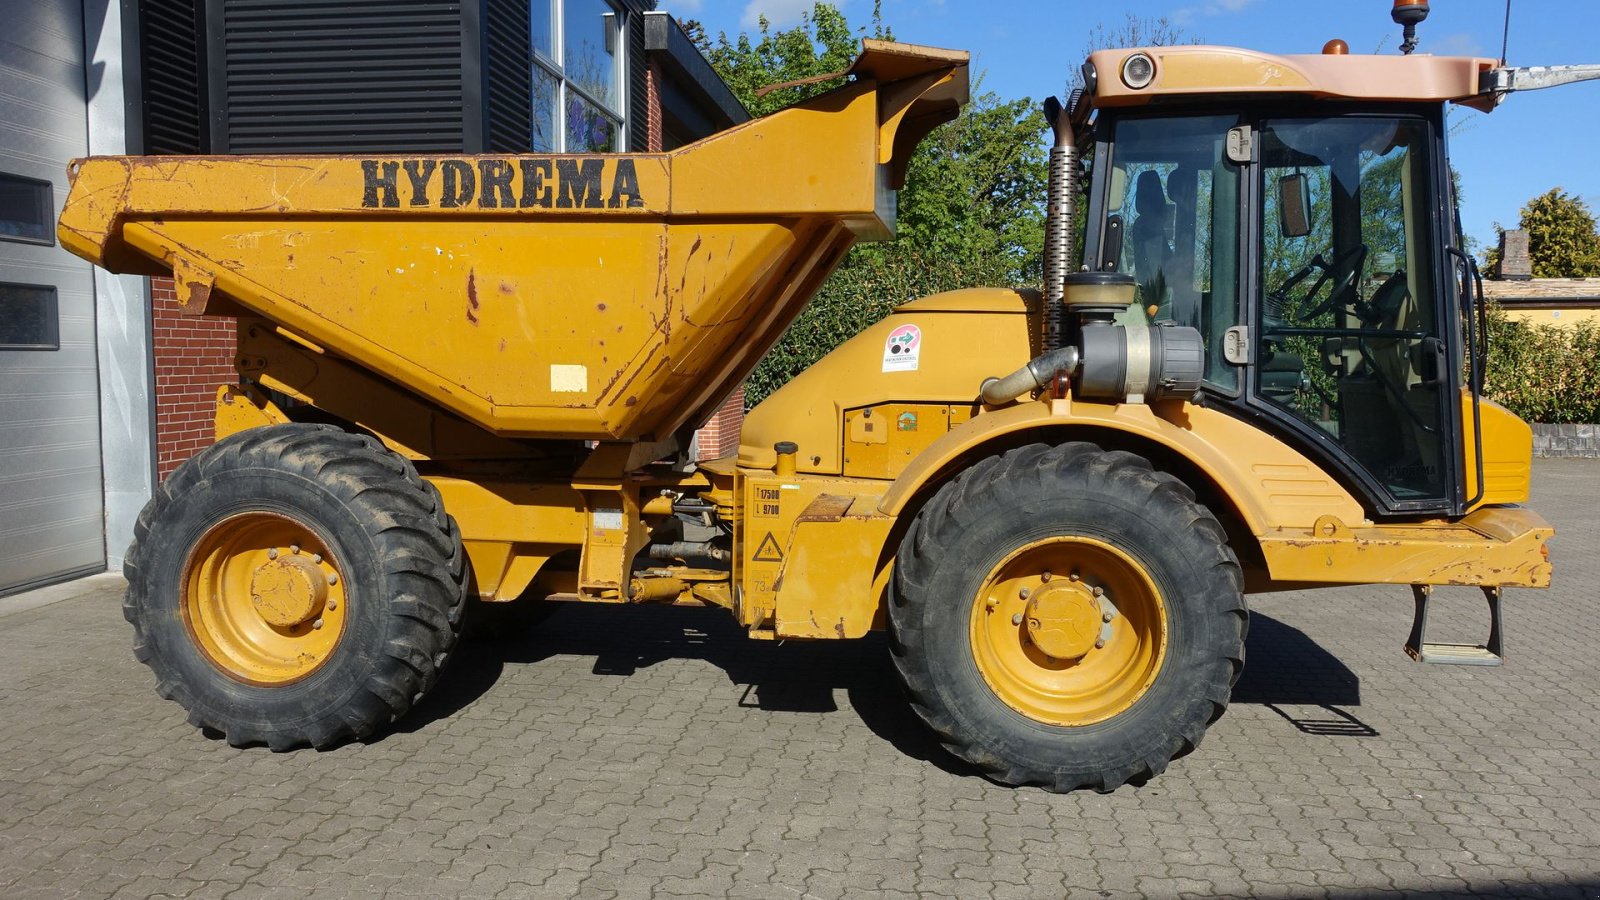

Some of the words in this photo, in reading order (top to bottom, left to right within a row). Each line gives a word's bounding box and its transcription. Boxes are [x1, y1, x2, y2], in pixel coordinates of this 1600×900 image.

[361, 159, 644, 208] HYDREMA
[760, 489, 779, 500] 17500
[763, 504, 779, 515] 9700
[754, 580, 766, 592] 73
